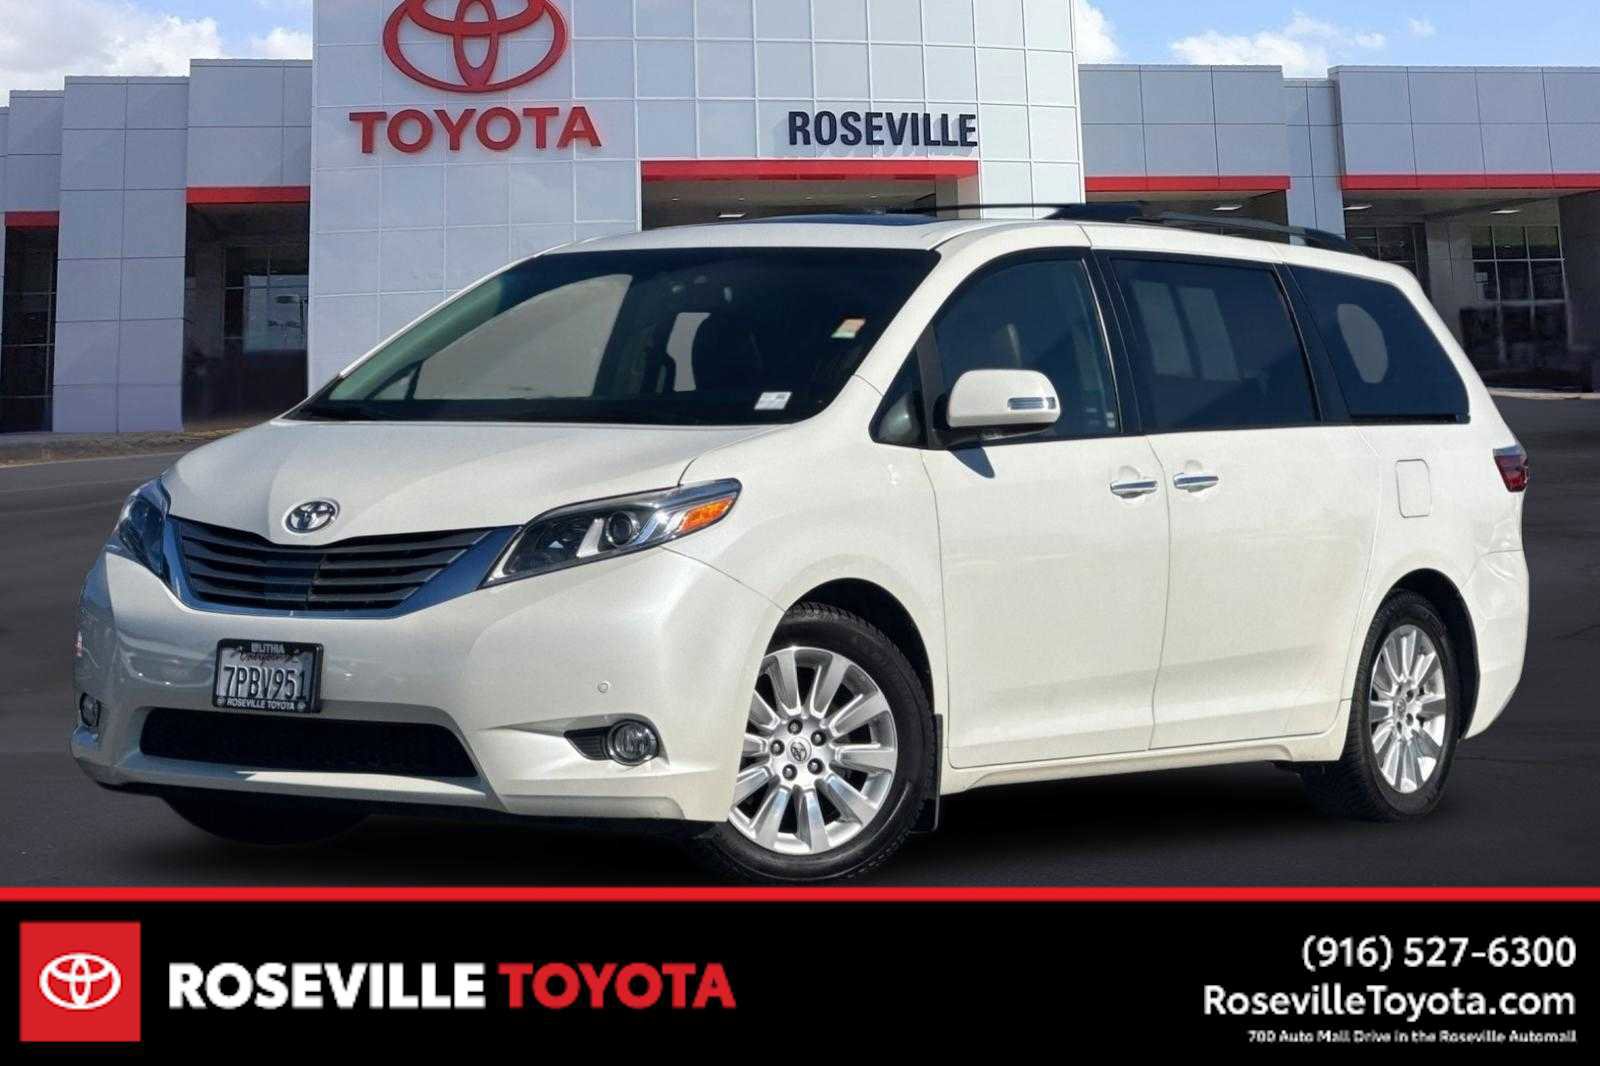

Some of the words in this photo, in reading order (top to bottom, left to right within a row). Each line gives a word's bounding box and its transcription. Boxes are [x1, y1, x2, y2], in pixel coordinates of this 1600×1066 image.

[349, 106, 602, 154] TOYOTA
[788, 111, 978, 147] ROSEVILLE
[222, 665, 307, 700] 7PBV951
[227, 698, 266, 709] ROSEVILLE
[267, 700, 295, 711] TOYOTA
